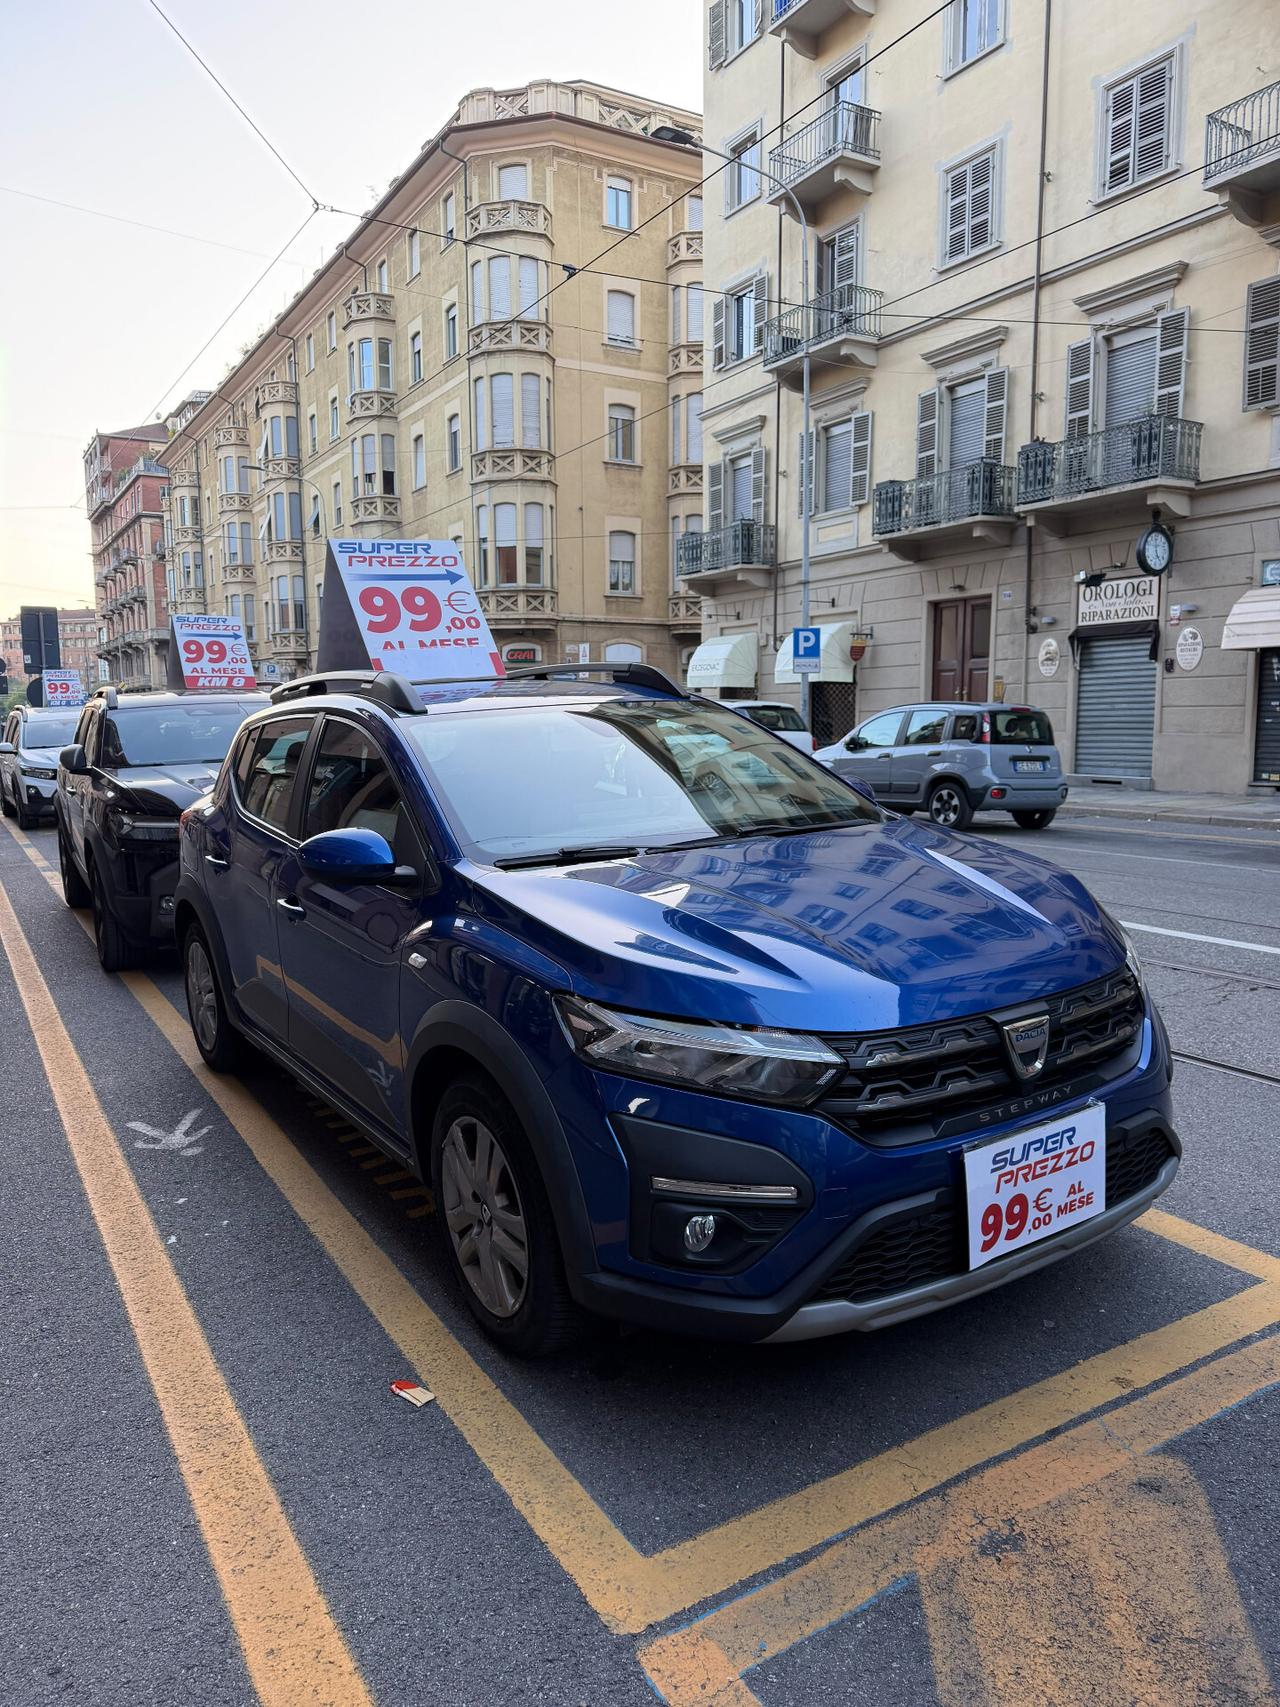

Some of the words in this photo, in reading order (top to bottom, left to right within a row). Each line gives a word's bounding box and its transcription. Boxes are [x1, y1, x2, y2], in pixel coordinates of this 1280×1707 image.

[338, 542, 432, 554] SUPER
[348, 555, 458, 567] PREZZO
[1083, 580, 1153, 602] OROLOGI
[359, 586, 442, 634] 99
[443, 590, 477, 614] €
[1081, 605, 1154, 622] RIPARAZIONI
[175, 616, 228, 624] SUPER
[180, 623, 241, 631] PREZZO
[183, 640, 227, 663] 99
[798, 631, 816, 655] P
[211, 667, 246, 675] MESE
[47, 682, 70, 694] 99
[197, 677, 229, 687] KM
[1015, 1027, 1046, 1042] DACIA
[980, 1085, 1072, 1122] STEPWAY
[990, 1126, 1077, 1173] SUPER
[995, 1140, 1095, 1194] PREZZO
[1066, 1180, 1085, 1198] AL
[1057, 1191, 1095, 1218] MESE
[980, 1193, 1029, 1253] 99
[1032, 1188, 1053, 1213] €
